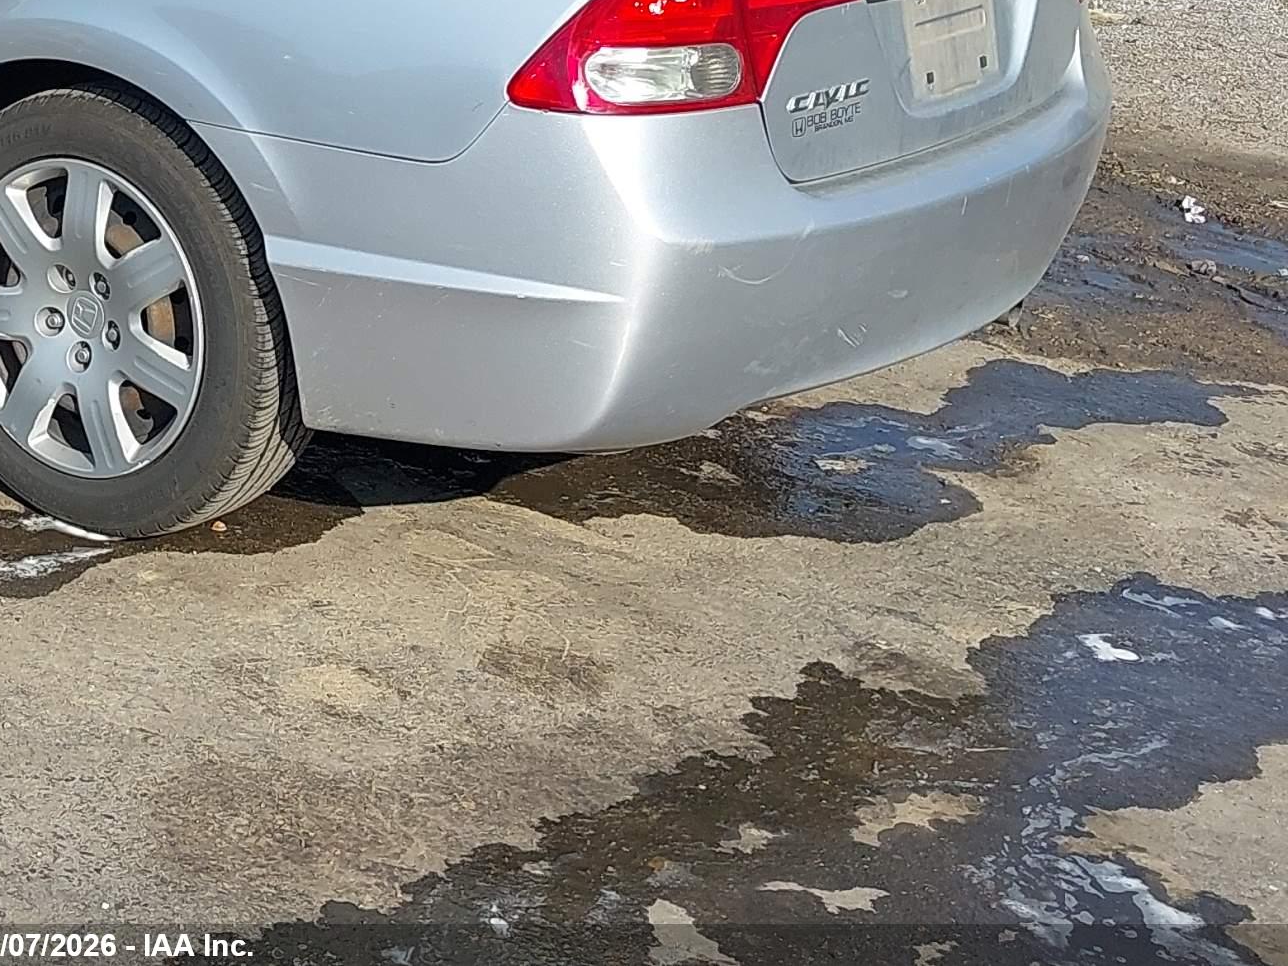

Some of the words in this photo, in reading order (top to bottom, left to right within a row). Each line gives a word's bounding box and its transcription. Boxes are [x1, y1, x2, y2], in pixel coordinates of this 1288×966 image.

[786, 78, 870, 113] CIVIC
[807, 111, 827, 127] BOB
[831, 101, 861, 121] BOYTE
